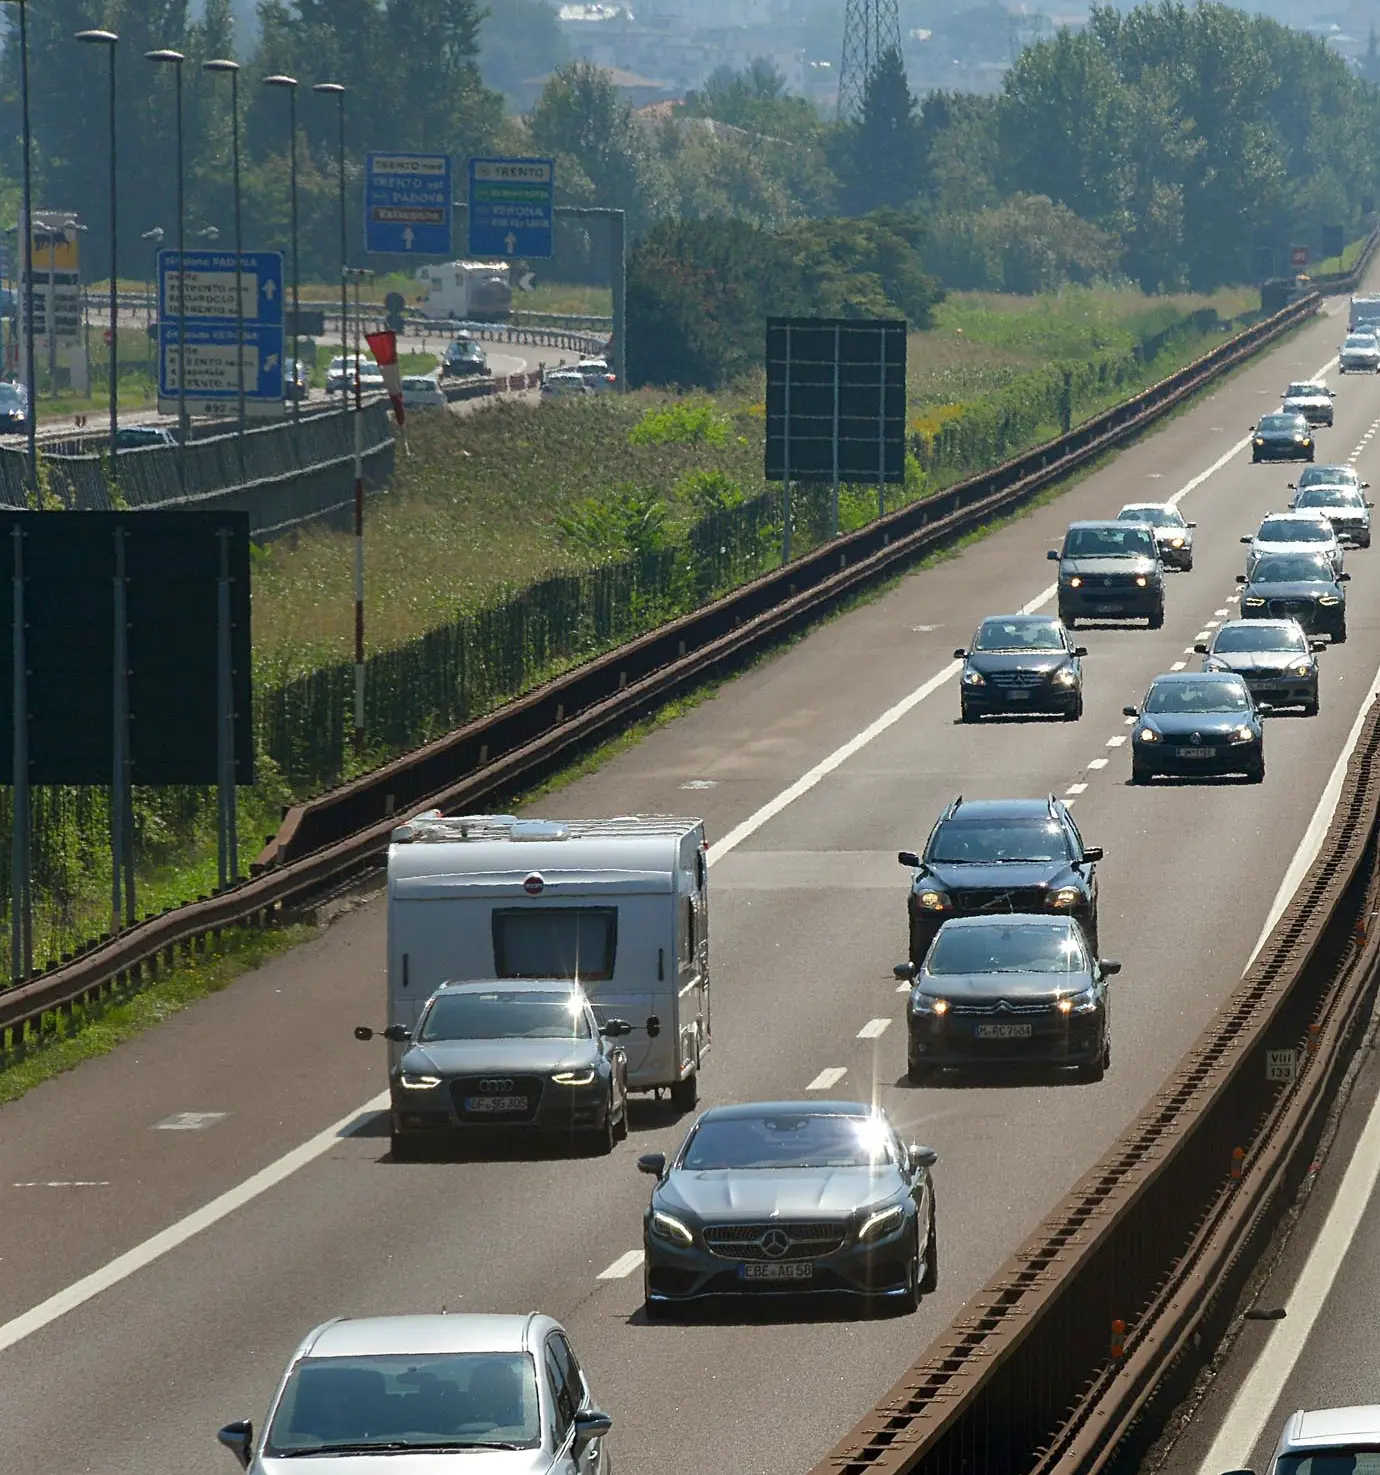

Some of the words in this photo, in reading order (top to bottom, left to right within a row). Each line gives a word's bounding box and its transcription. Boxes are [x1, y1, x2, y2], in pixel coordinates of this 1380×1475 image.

[495, 168, 545, 178] TRENTO
[1271, 1053, 1291, 1063] VIII
[1271, 1067, 1291, 1078] 133
